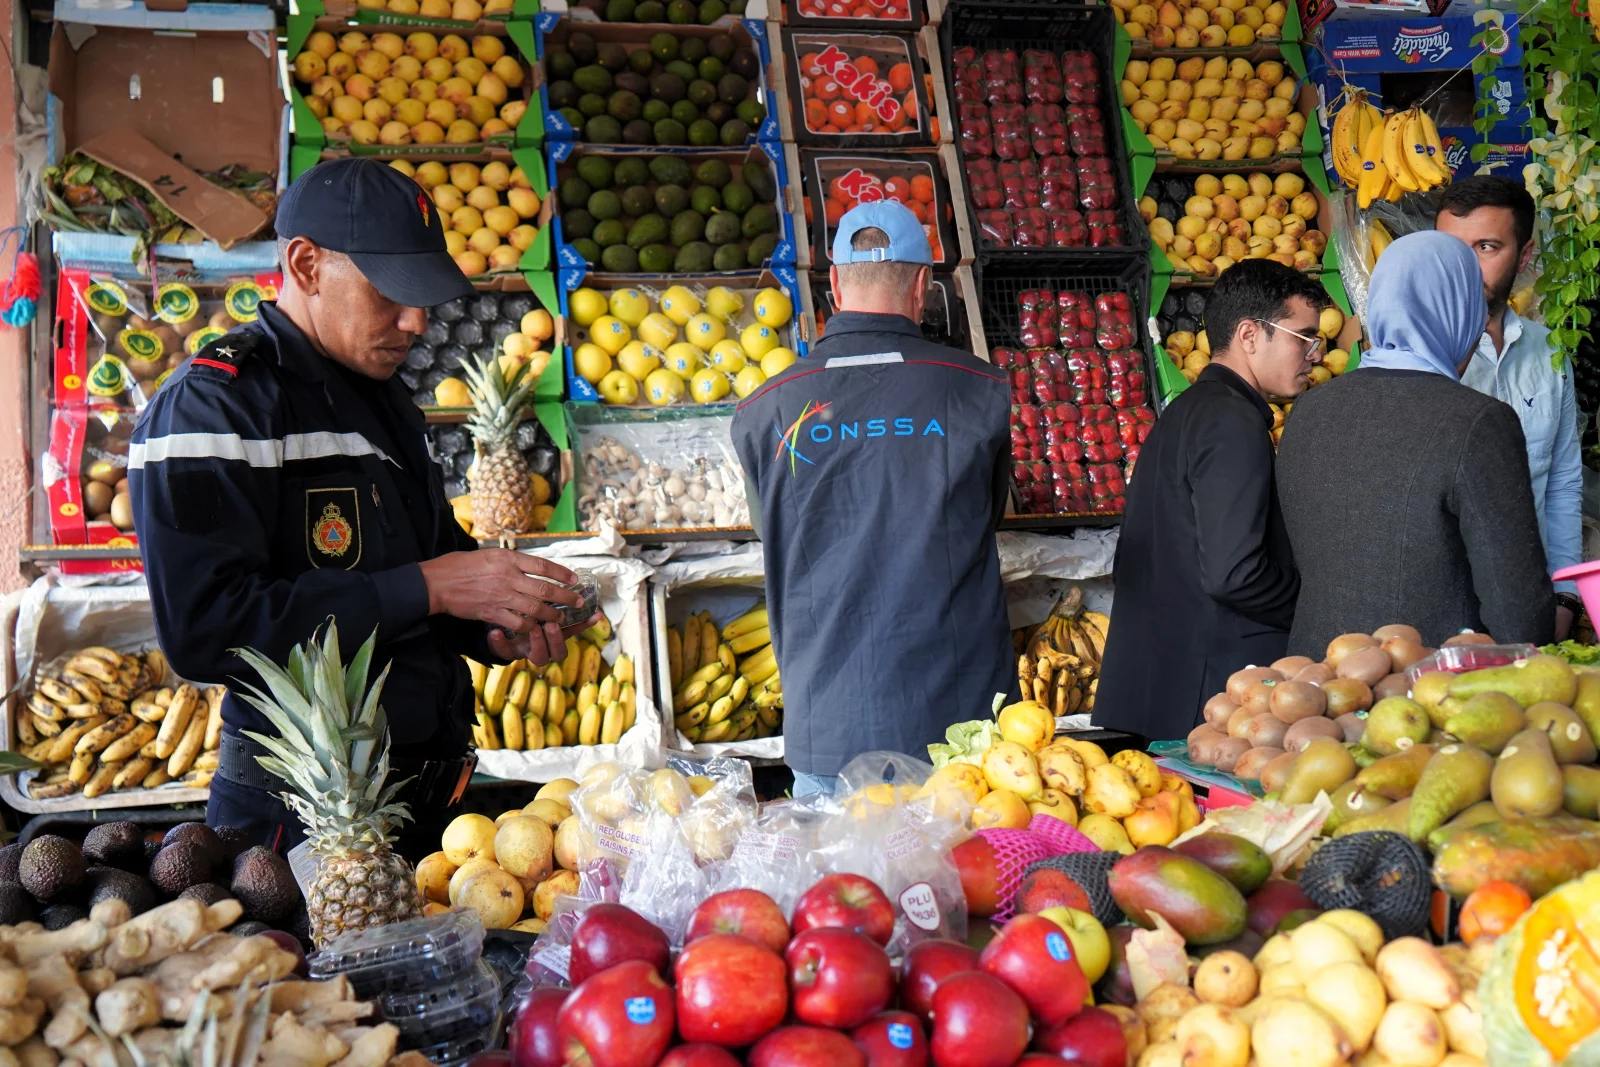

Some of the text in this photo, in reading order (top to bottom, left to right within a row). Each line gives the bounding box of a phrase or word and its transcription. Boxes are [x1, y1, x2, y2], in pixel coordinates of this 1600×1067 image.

[1392, 31, 1453, 63] Frutadeli
[815, 45, 900, 122] Kakis
[810, 418, 945, 443] ONSSA
[111, 559, 144, 569] KIW
[599, 825, 614, 836] RED
[615, 830, 641, 844] GLOBE
[777, 837, 799, 847] SEEDS
[599, 838, 628, 855] RAISINS
[907, 892, 931, 906] PLU
